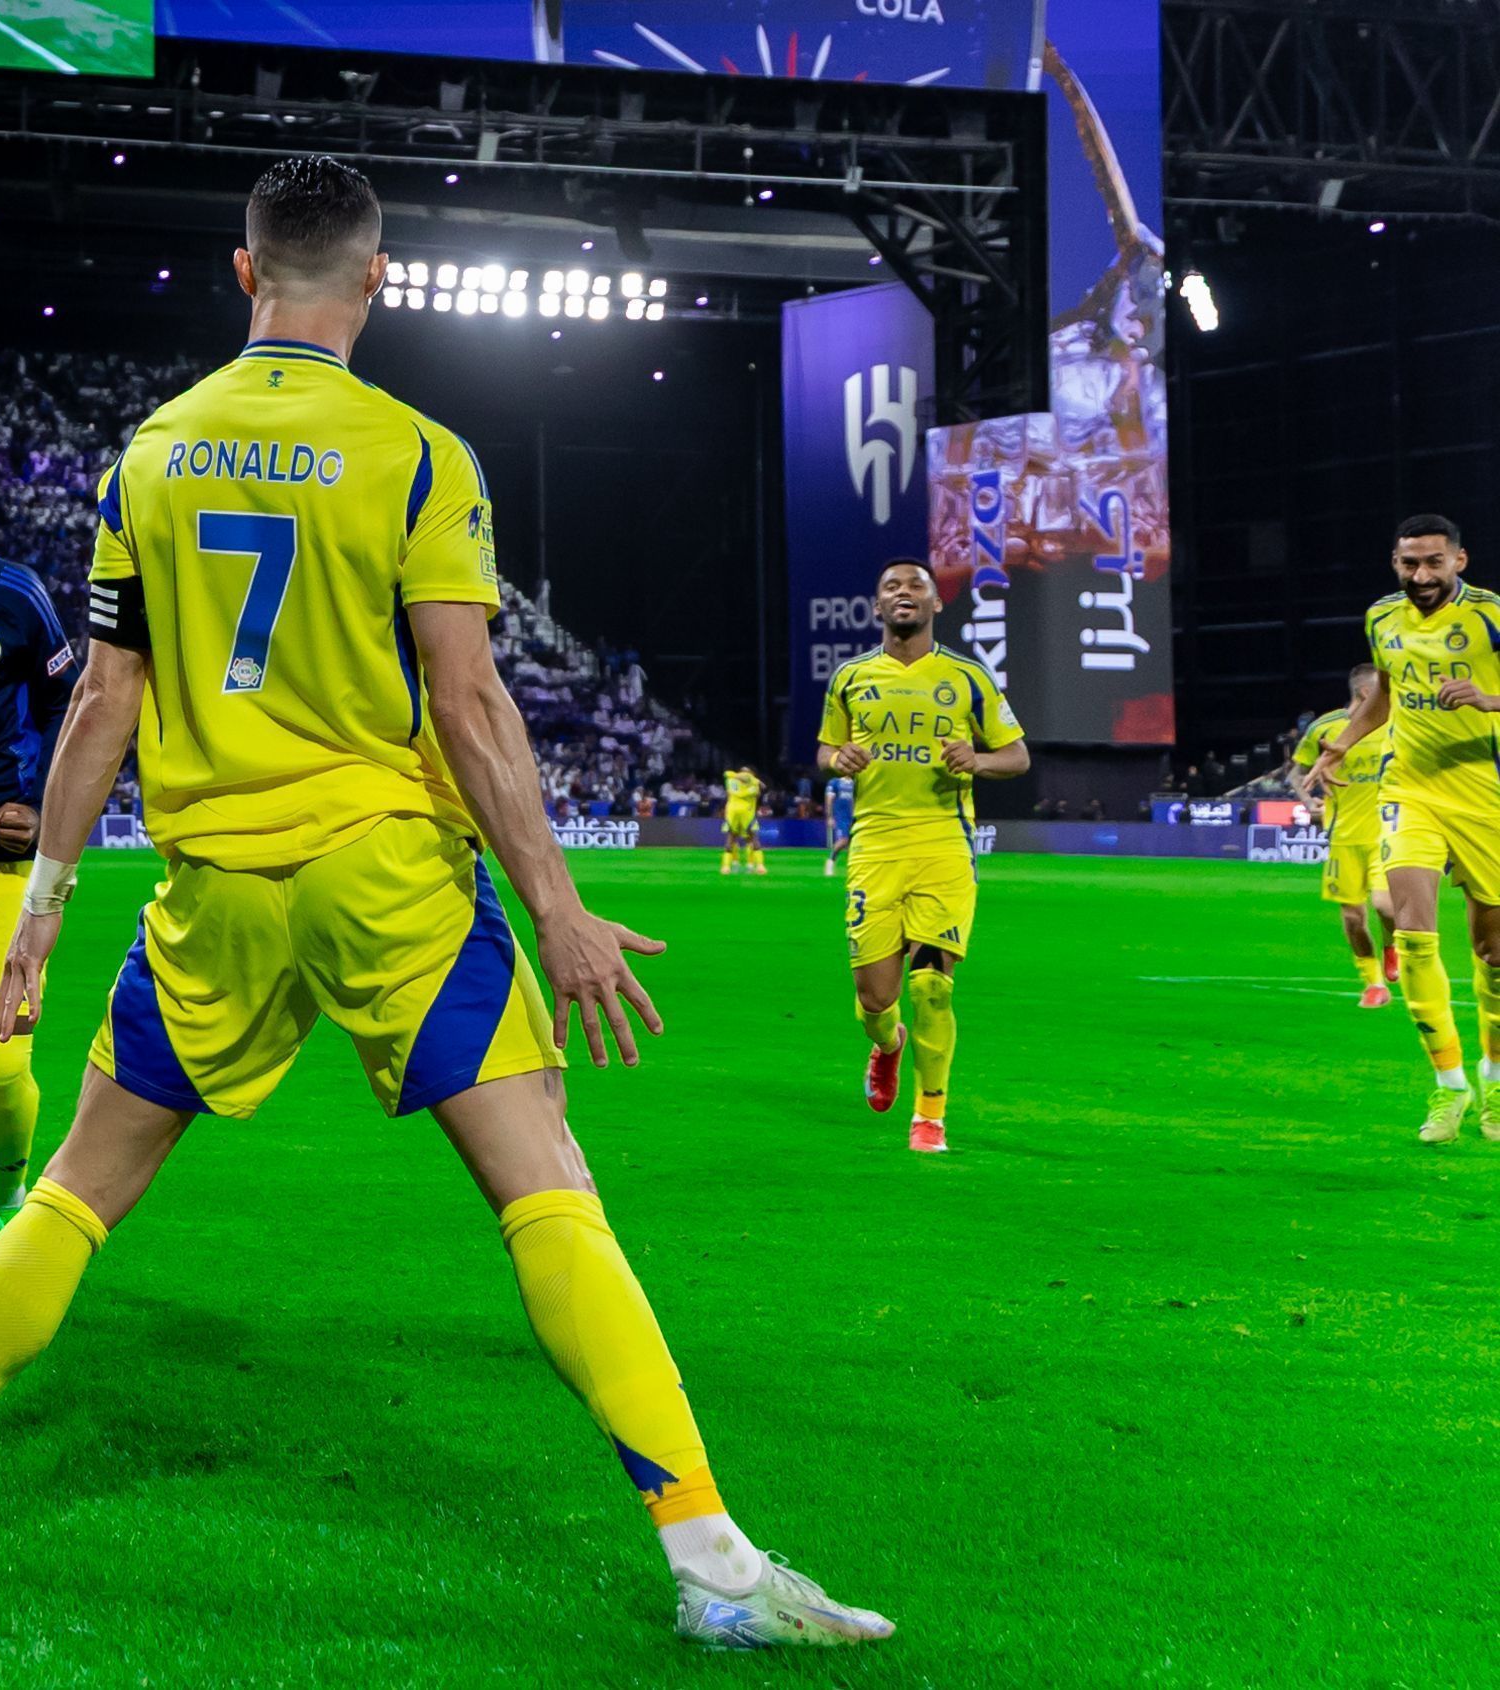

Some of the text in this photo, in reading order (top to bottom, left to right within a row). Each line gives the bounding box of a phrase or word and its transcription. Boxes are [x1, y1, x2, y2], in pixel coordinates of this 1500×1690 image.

[856, 0, 945, 25] COLA
[166, 438, 344, 487] RONALDO
[196, 509, 298, 695] 7
[1387, 661, 1472, 685] AFD
[857, 711, 954, 738] KAFD
[882, 743, 932, 764] SHG
[1381, 802, 1399, 831] 9
